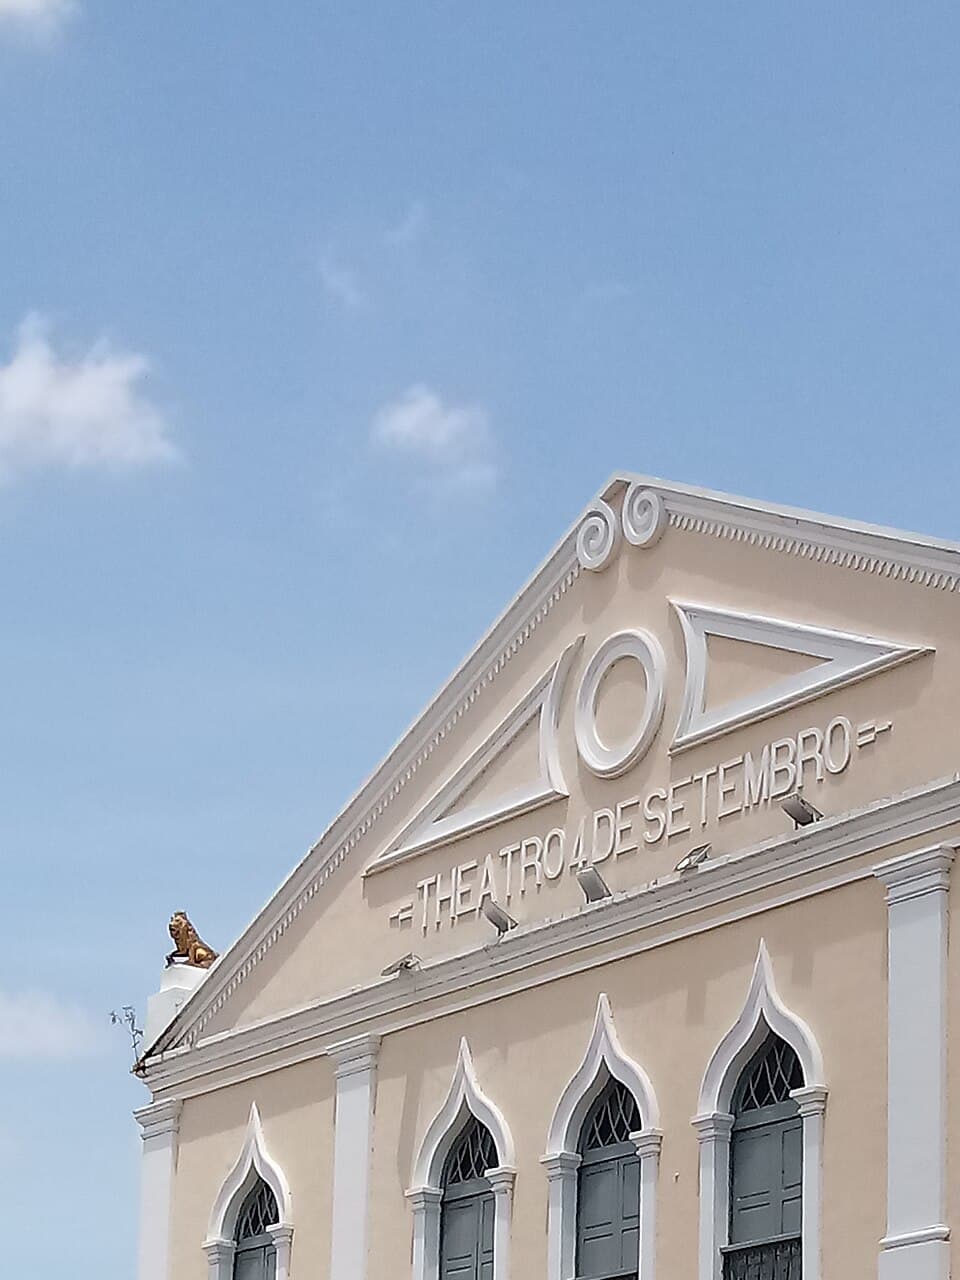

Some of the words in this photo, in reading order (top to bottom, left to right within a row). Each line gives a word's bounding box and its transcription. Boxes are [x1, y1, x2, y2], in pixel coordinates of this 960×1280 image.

[416, 827, 567, 929] THEATRO
[568, 816, 588, 869] 4
[591, 796, 641, 866] DE
[643, 715, 852, 844] SETEMBRO
